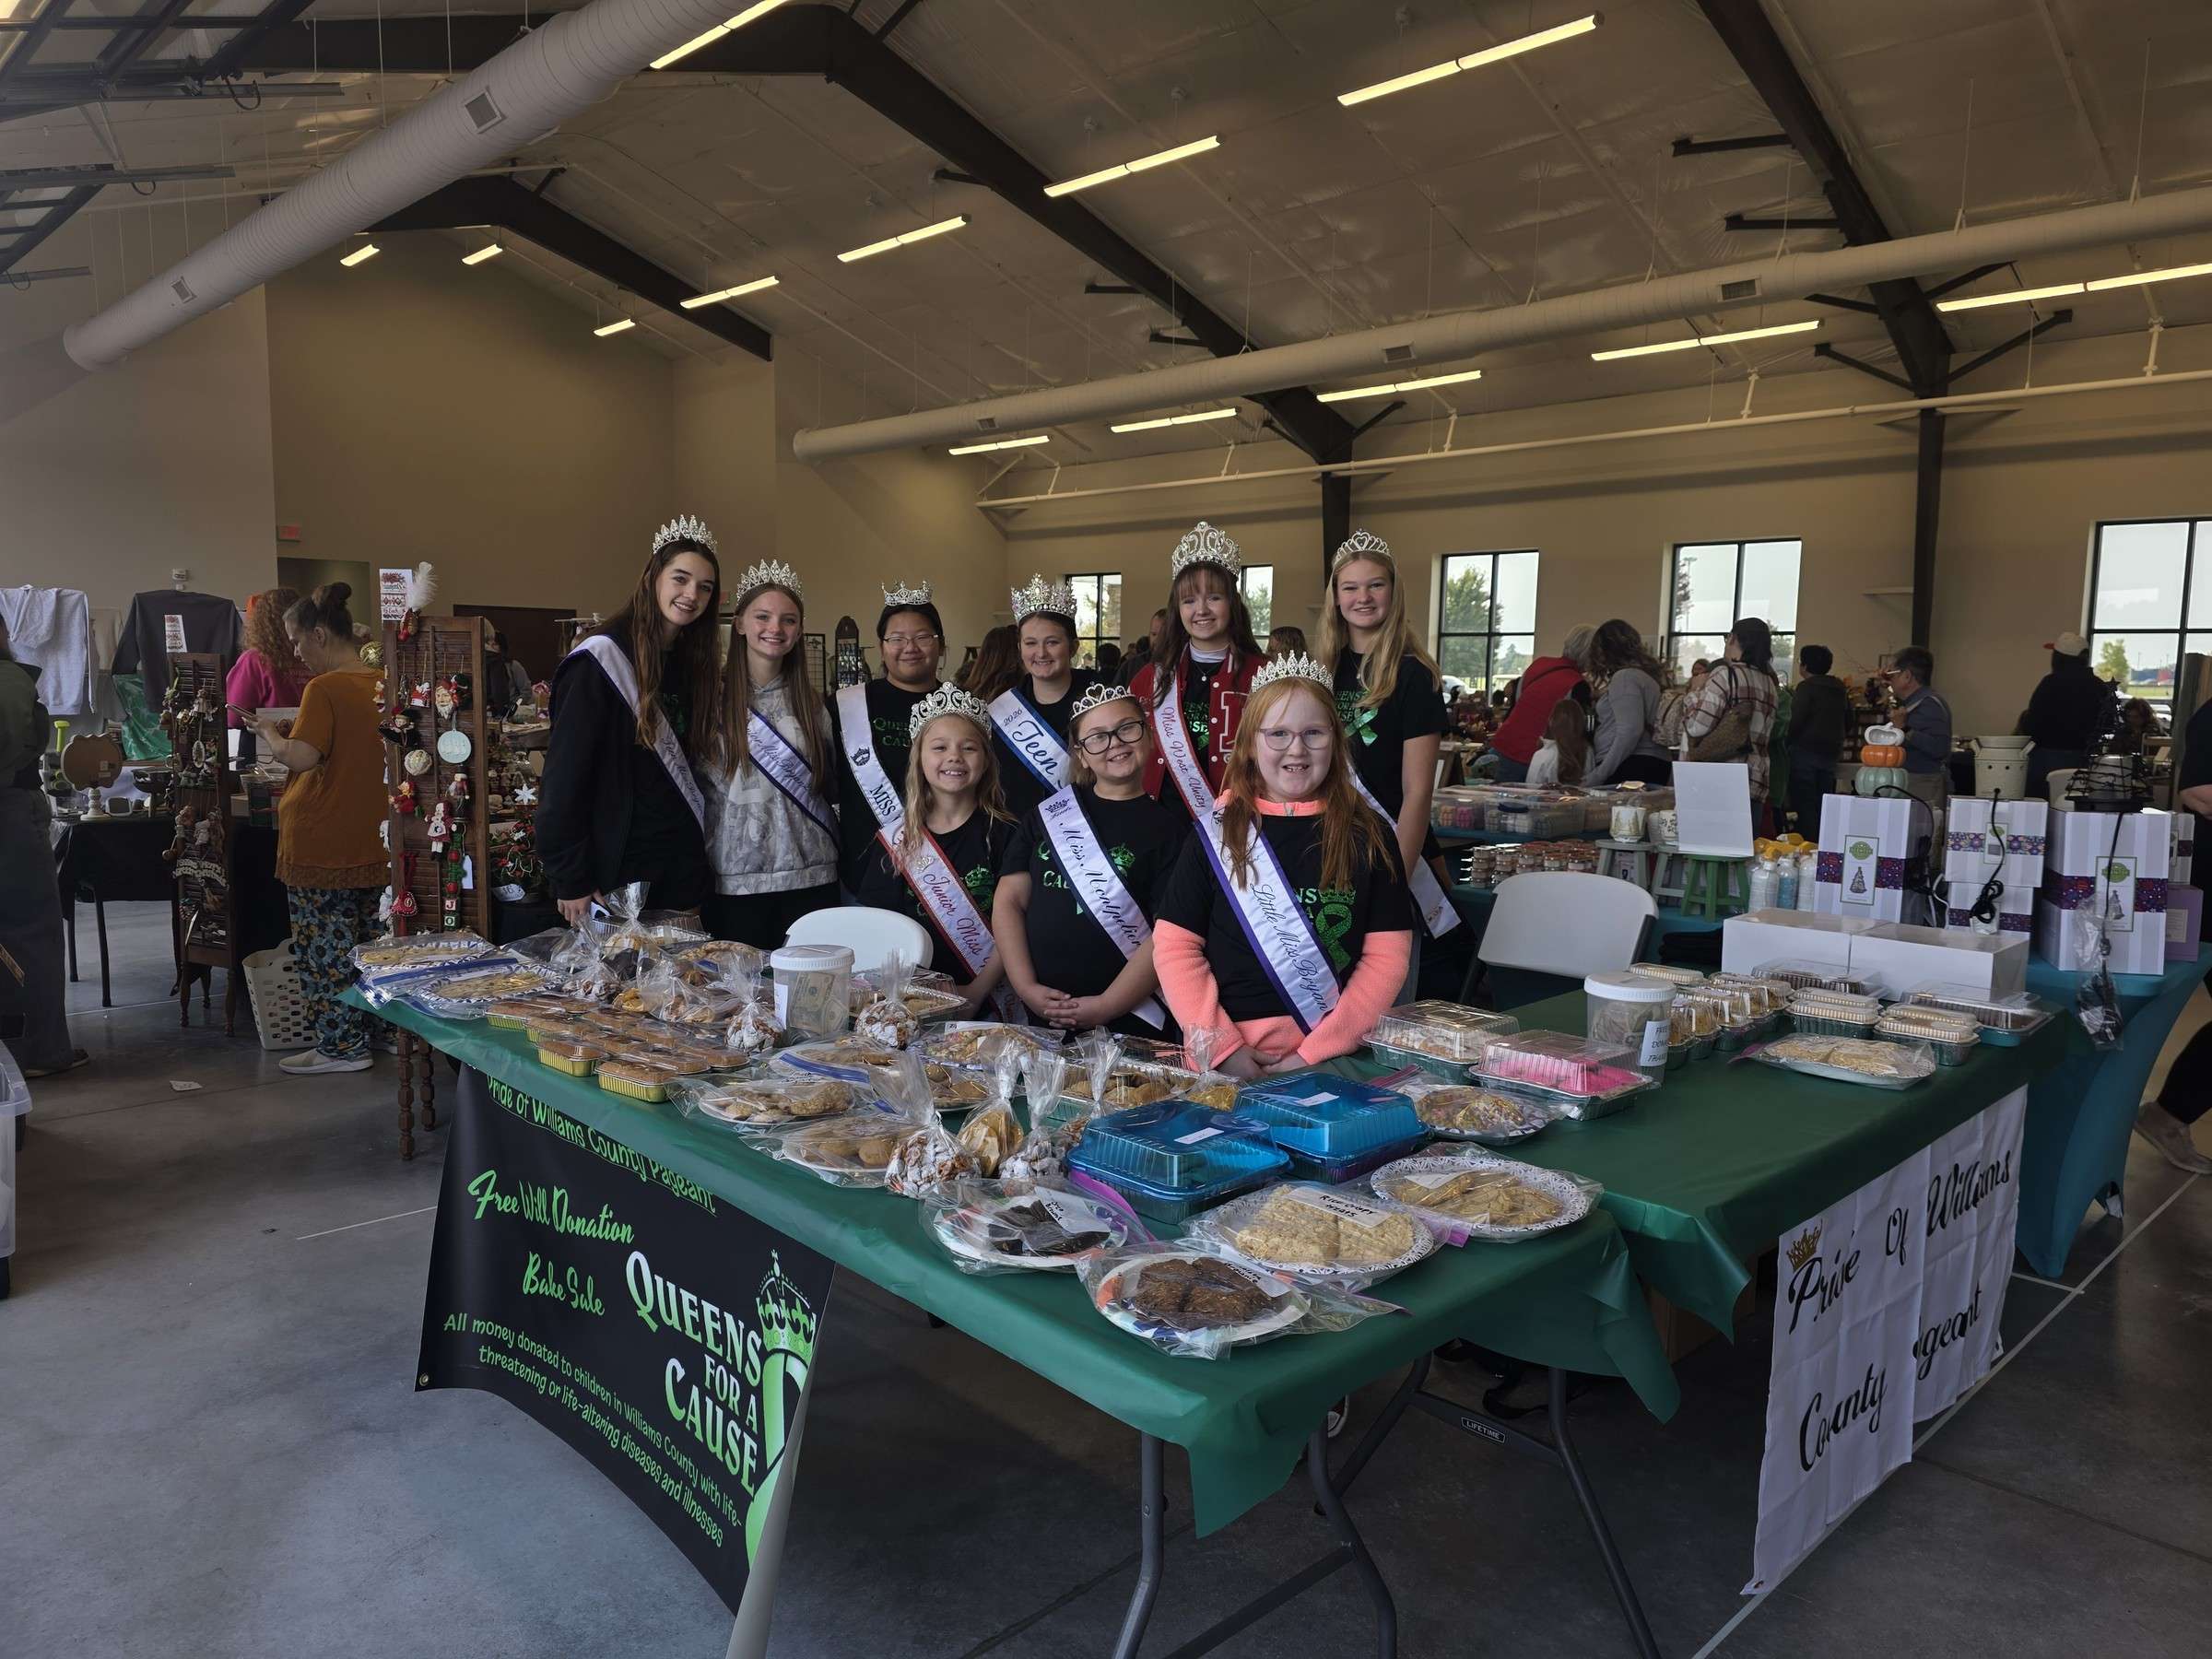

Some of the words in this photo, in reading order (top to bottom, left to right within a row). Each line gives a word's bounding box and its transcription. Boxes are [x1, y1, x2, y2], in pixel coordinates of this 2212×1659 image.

[1003, 708, 1023, 726] 2026
[1012, 720, 1058, 775] Teen
[1161, 706, 1176, 738] Miss
[1170, 740, 1189, 774] West
[1189, 777, 1206, 808] Unity
[869, 784, 896, 817] MISS
[1060, 822, 1086, 861] Miss
[924, 873, 958, 915] Junior
[956, 917, 983, 955] Miss
[1250, 884, 1287, 924] Little
[1274, 924, 1301, 959] Miss
[1292, 959, 1329, 1011] Bryan
[533, 1098, 586, 1148] Williams
[587, 1126, 647, 1182] County
[649, 1158, 716, 1214] Pageant
[467, 1170, 520, 1220] Free
[519, 1180, 550, 1226] Will
[553, 1184, 635, 1244] Donation
[523, 1251, 566, 1301] Bake
[566, 1265, 606, 1316] Sale
[626, 1251, 763, 1387] QUEENS
[443, 1312, 467, 1332] All
[472, 1319, 515, 1348] money
[518, 1330, 559, 1370] donated
[560, 1356, 572, 1377] to
[574, 1368, 612, 1407] children
[613, 1393, 623, 1416] in
[624, 1401, 663, 1450] Williams
[664, 1435, 699, 1488] County
[700, 1470, 722, 1512] with
[722, 1491, 743, 1527] life-
[665, 1357, 759, 1497] CAUSE
[704, 1353, 741, 1416] FOR
[745, 1393, 759, 1435] A
[1466, 1420, 1500, 1440] LIFETIME
[478, 1345, 548, 1394] threatening
[548, 1381, 561, 1399] or
[561, 1384, 620, 1449] life-altering
[621, 1432, 663, 1484] diseases
[660, 1471, 683, 1501] and
[682, 1486, 724, 1548] illnesses
